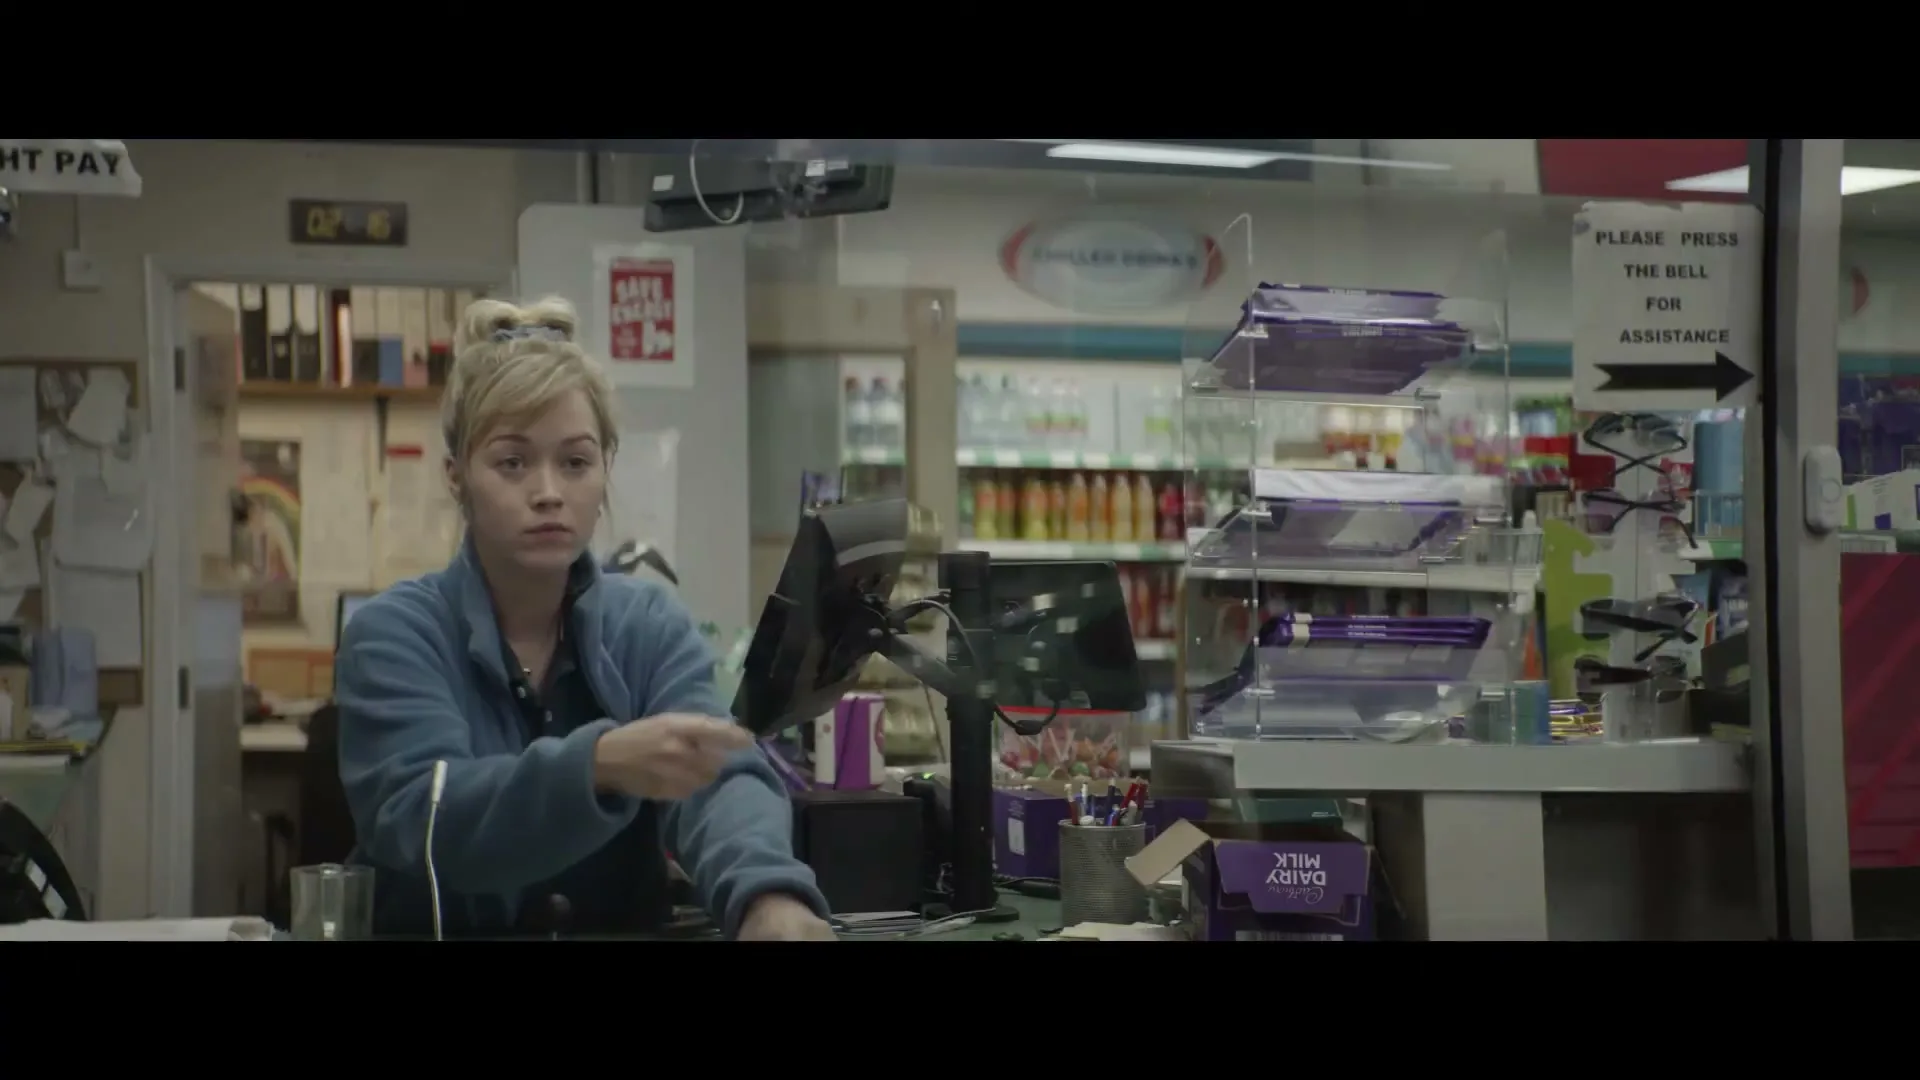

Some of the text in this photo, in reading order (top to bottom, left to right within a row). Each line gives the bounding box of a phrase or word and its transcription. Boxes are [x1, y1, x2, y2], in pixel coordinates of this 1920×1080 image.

[55, 149, 119, 176] PAY
[1595, 231, 1739, 247] PLEASE PRESS
[1623, 263, 1709, 279] THE BELL
[1645, 296, 1682, 312] FOR
[1619, 328, 1731, 344] ASSISTANCE
[1272, 851, 1321, 869] MILK
[1265, 868, 1327, 887] DAIRY
[1266, 884, 1325, 905] Cadbury
